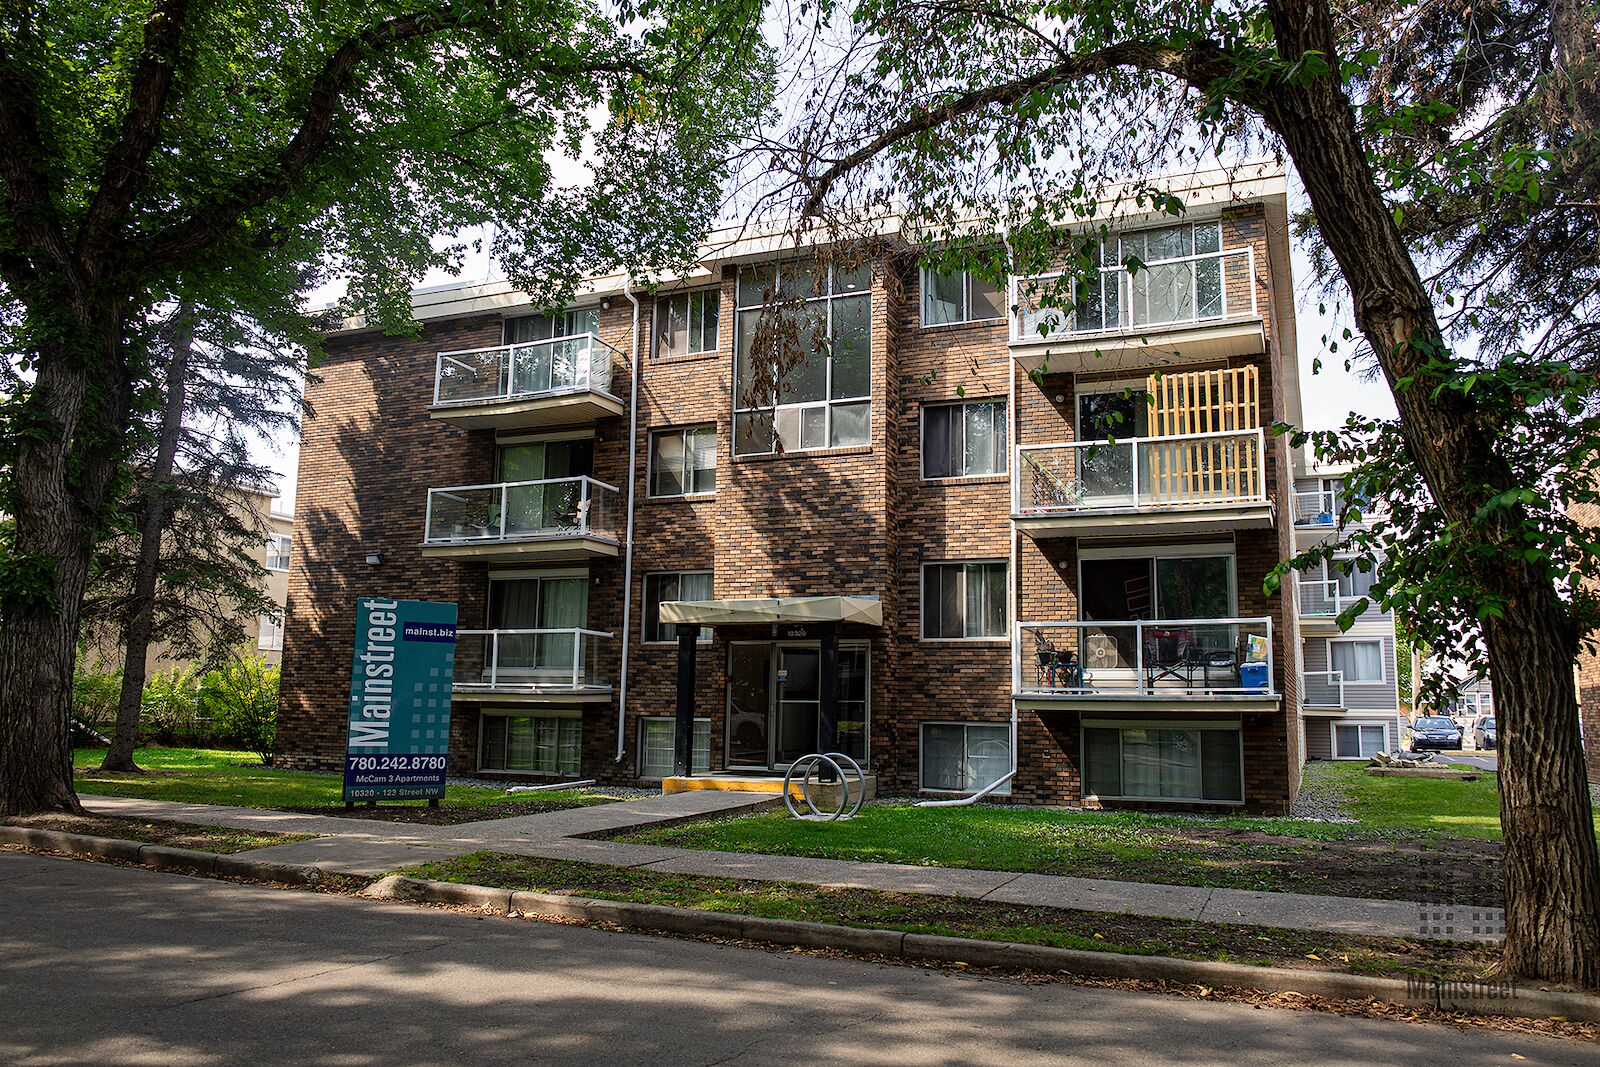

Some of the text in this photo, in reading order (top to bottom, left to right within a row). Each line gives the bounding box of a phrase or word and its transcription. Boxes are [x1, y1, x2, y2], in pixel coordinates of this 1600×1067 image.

[405, 627, 454, 638] mainst.biz
[348, 600, 398, 747] Mainstreet
[349, 756, 446, 770] 780.242.8780
[355, 774, 440, 783] McCam 3 Apartments
[350, 789, 375, 797] 10320
[398, 788, 423, 796] Street
